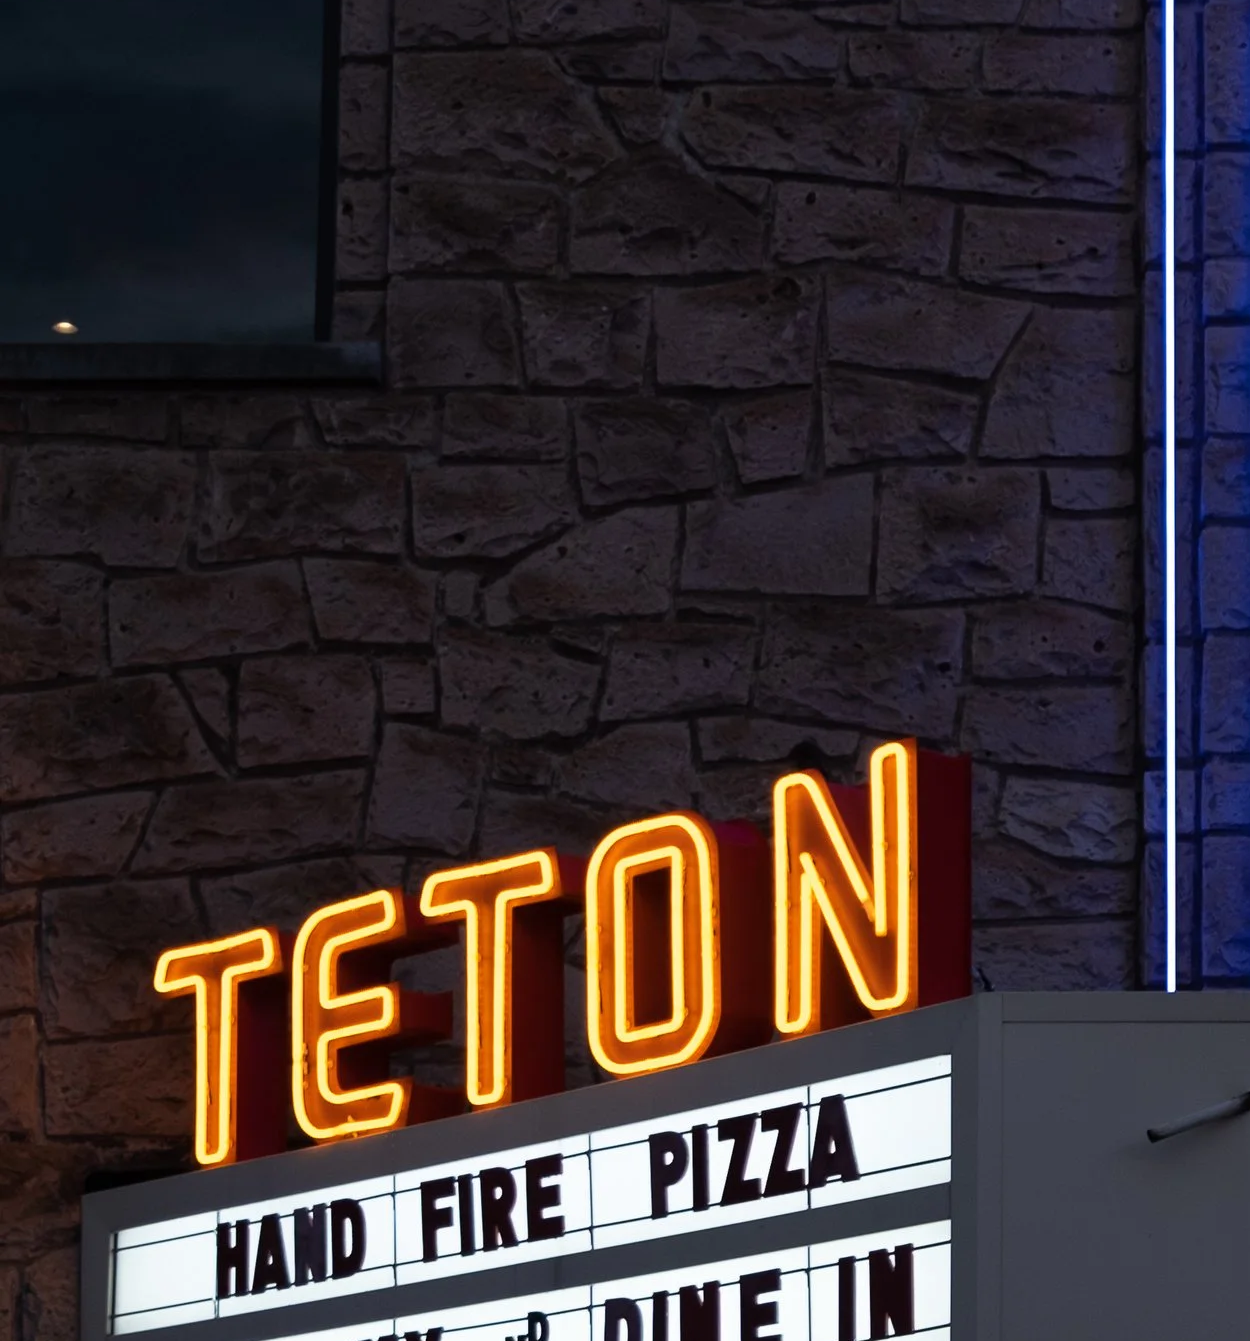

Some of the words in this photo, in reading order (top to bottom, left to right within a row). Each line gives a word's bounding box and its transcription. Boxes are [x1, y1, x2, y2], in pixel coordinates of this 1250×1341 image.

[153, 738, 918, 1165] TETON
[215, 1197, 367, 1297] HAND
[420, 1153, 567, 1262] FIRE
[647, 1094, 860, 1219] PIZZA
